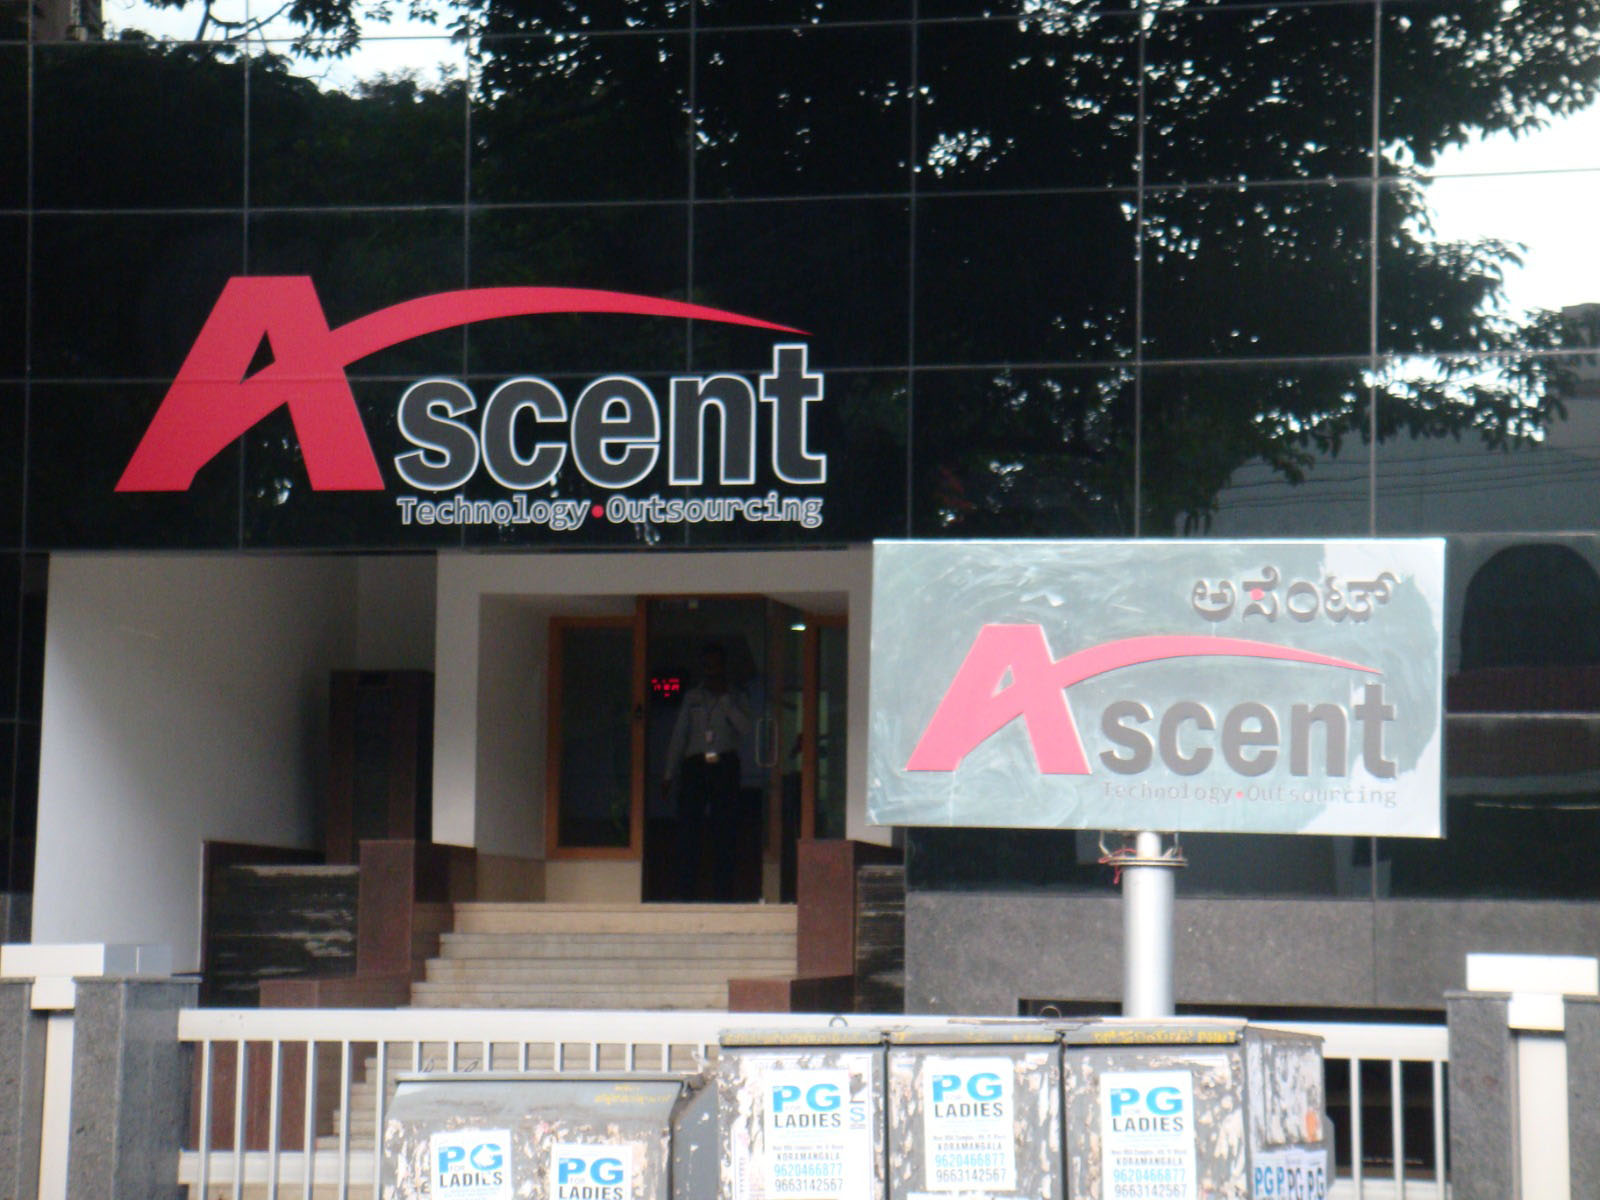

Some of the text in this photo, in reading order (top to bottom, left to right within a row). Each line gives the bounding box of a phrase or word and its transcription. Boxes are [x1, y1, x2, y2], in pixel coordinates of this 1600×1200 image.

[114, 275, 827, 492] Ascent
[397, 491, 824, 530] Technology Outsourcing
[905, 623, 1397, 779] Ascent
[1102, 782, 1398, 809] Technology Outsourcing
[772, 1083, 841, 1113] PG
[931, 1072, 1003, 1103] PG
[1110, 1086, 1184, 1117] PG
[774, 1113, 841, 1128] LADIES
[935, 1102, 1004, 1118] LADIES
[1112, 1117, 1184, 1132] LADIES
[438, 1143, 503, 1174] PG
[558, 1157, 624, 1185] PG
[775, 1178, 844, 1192] 9663142567
[936, 1168, 1007, 1183] 9663142567
[559, 1185, 624, 1200] LADIES
